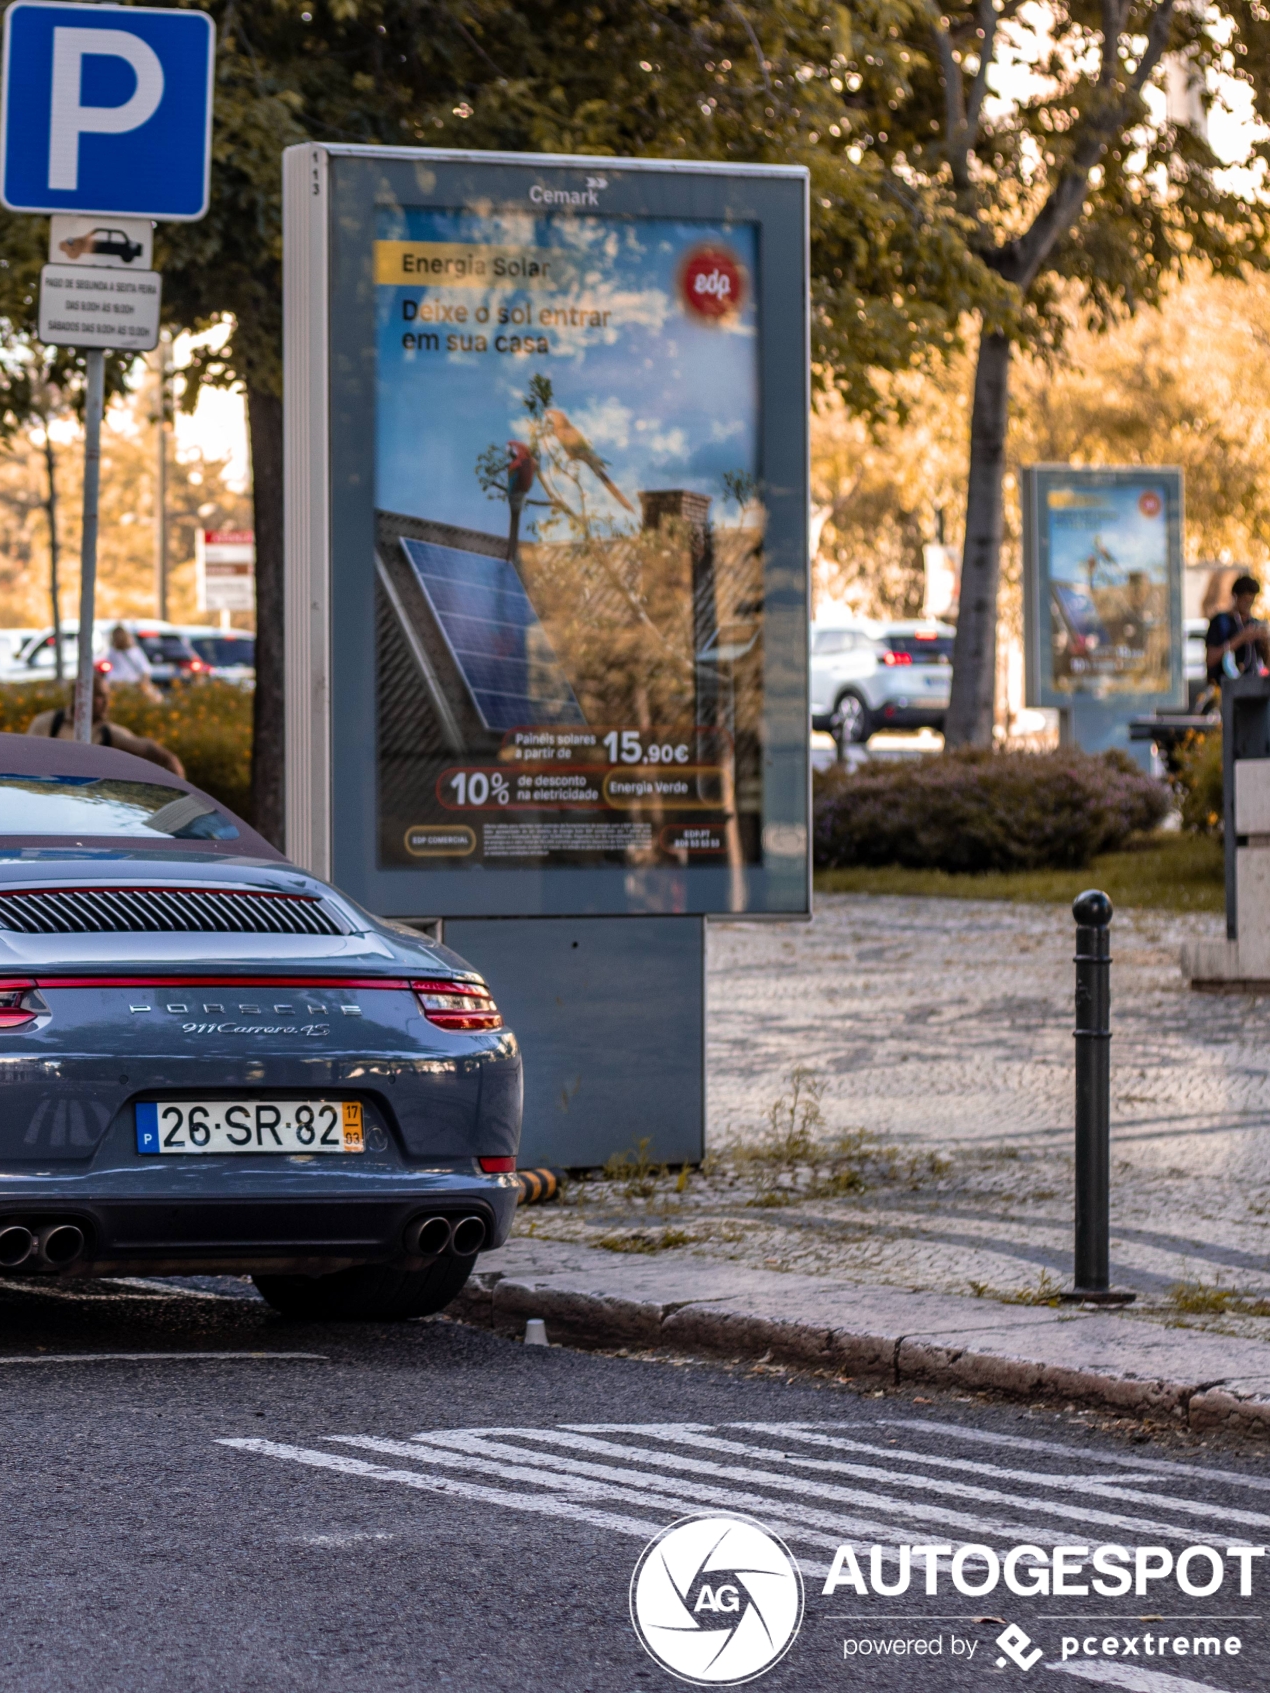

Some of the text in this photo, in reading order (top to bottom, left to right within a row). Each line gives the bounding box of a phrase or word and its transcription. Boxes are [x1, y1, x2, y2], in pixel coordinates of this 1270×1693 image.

[48, 26, 164, 191] P
[529, 185, 599, 206] Cemark
[402, 253, 551, 277] Energia Solar
[694, 268, 731, 300] edp
[402, 299, 612, 328] Deixe o sol entrar
[402, 331, 550, 354] em sua casa
[515, 732, 596, 746] Painéis solares
[524, 747, 555, 761] partir
[557, 747, 571, 759] de
[604, 731, 689, 765] 15,90€
[451, 772, 510, 805] 10%
[517, 775, 586, 788] de desconto
[610, 781, 688, 795] Energia Verde
[517, 789, 599, 801] na eletricidade
[412, 836, 468, 844] EDP COMERCIAL
[130, 1003, 362, 1016] PORSCHE
[346, 1105, 358, 1119] 17
[144, 1133, 152, 1145] P
[345, 1132, 360, 1145] 03
